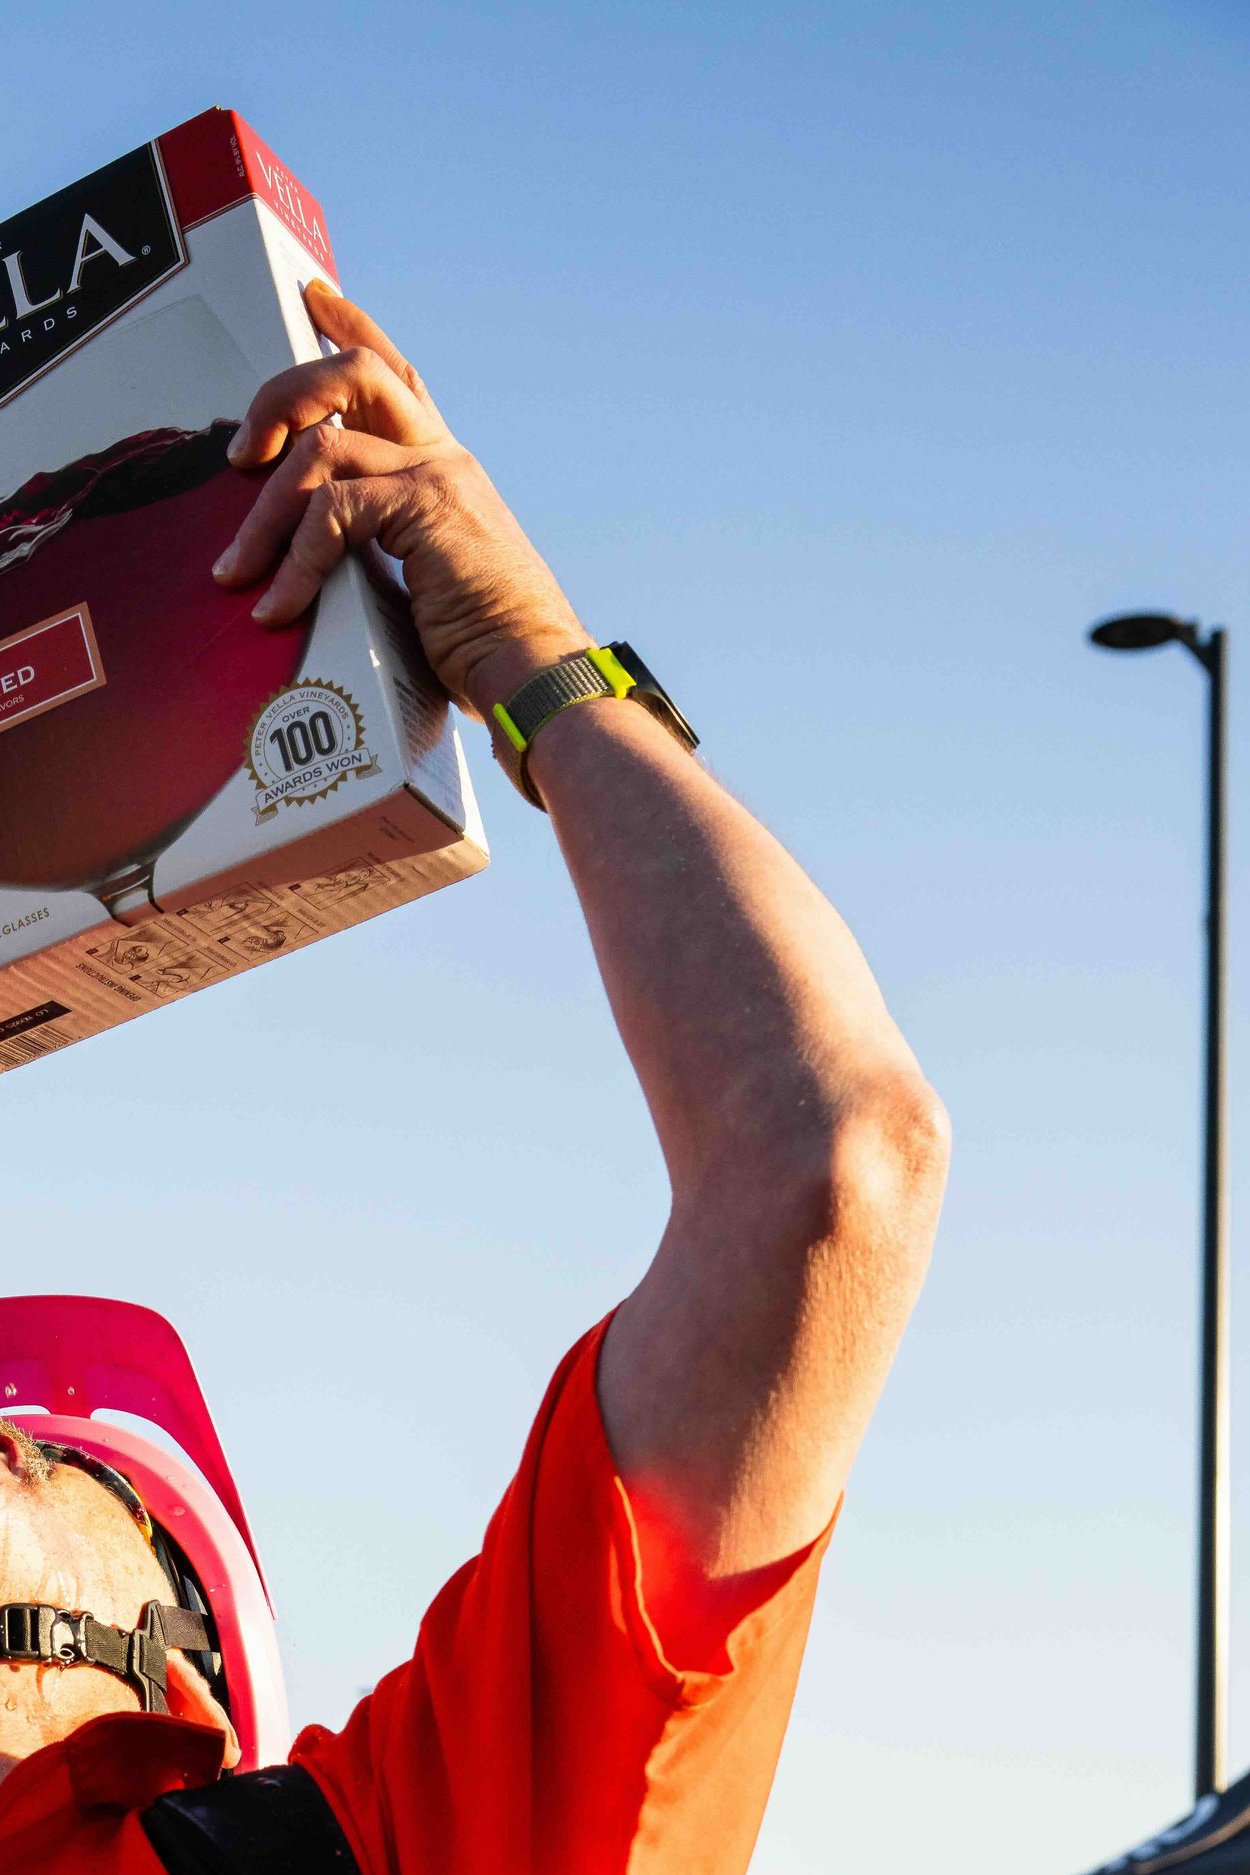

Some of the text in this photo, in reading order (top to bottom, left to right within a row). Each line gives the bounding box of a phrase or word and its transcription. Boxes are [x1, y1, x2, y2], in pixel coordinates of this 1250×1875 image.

[255, 151, 327, 253] VELLA
[254, 691, 350, 757] PETER VELLA VINEYARDS
[269, 710, 338, 772] 100
[282, 706, 311, 723] OVER
[264, 753, 362, 804] AWARDS WON
